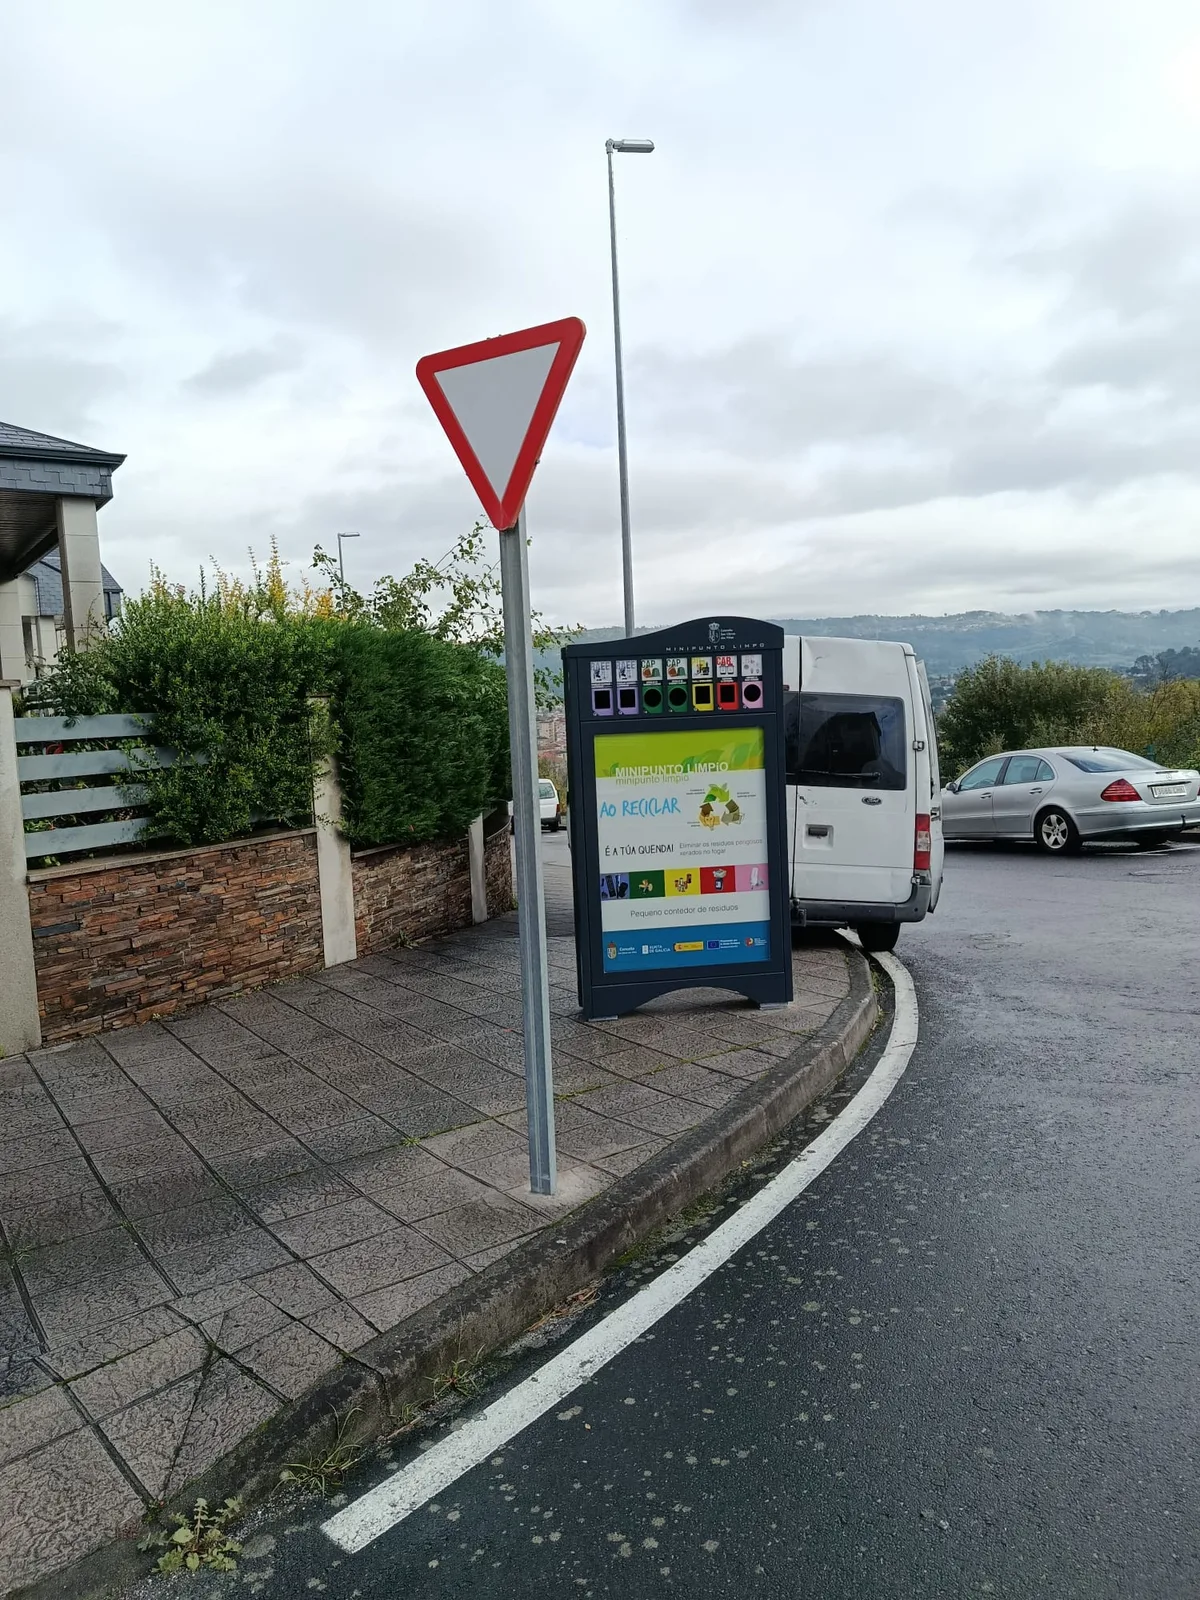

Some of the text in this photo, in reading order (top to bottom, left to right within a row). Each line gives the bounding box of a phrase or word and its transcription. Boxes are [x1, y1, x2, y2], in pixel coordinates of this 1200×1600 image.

[641, 659, 656, 668] CAP
[666, 658, 681, 667] CAP
[615, 764, 683, 777] MINIPUNTO
[615, 775, 660, 786] minipunto
[600, 798, 681, 818] AO RECICLAR
[604, 845, 611, 856] É
[612, 847, 618, 856] A
[620, 844, 636, 855] TÚA
[679, 841, 701, 849] Eliminar
[712, 847, 726, 856] fogar
[630, 904, 738, 918] Pequeno contedor de residuos
